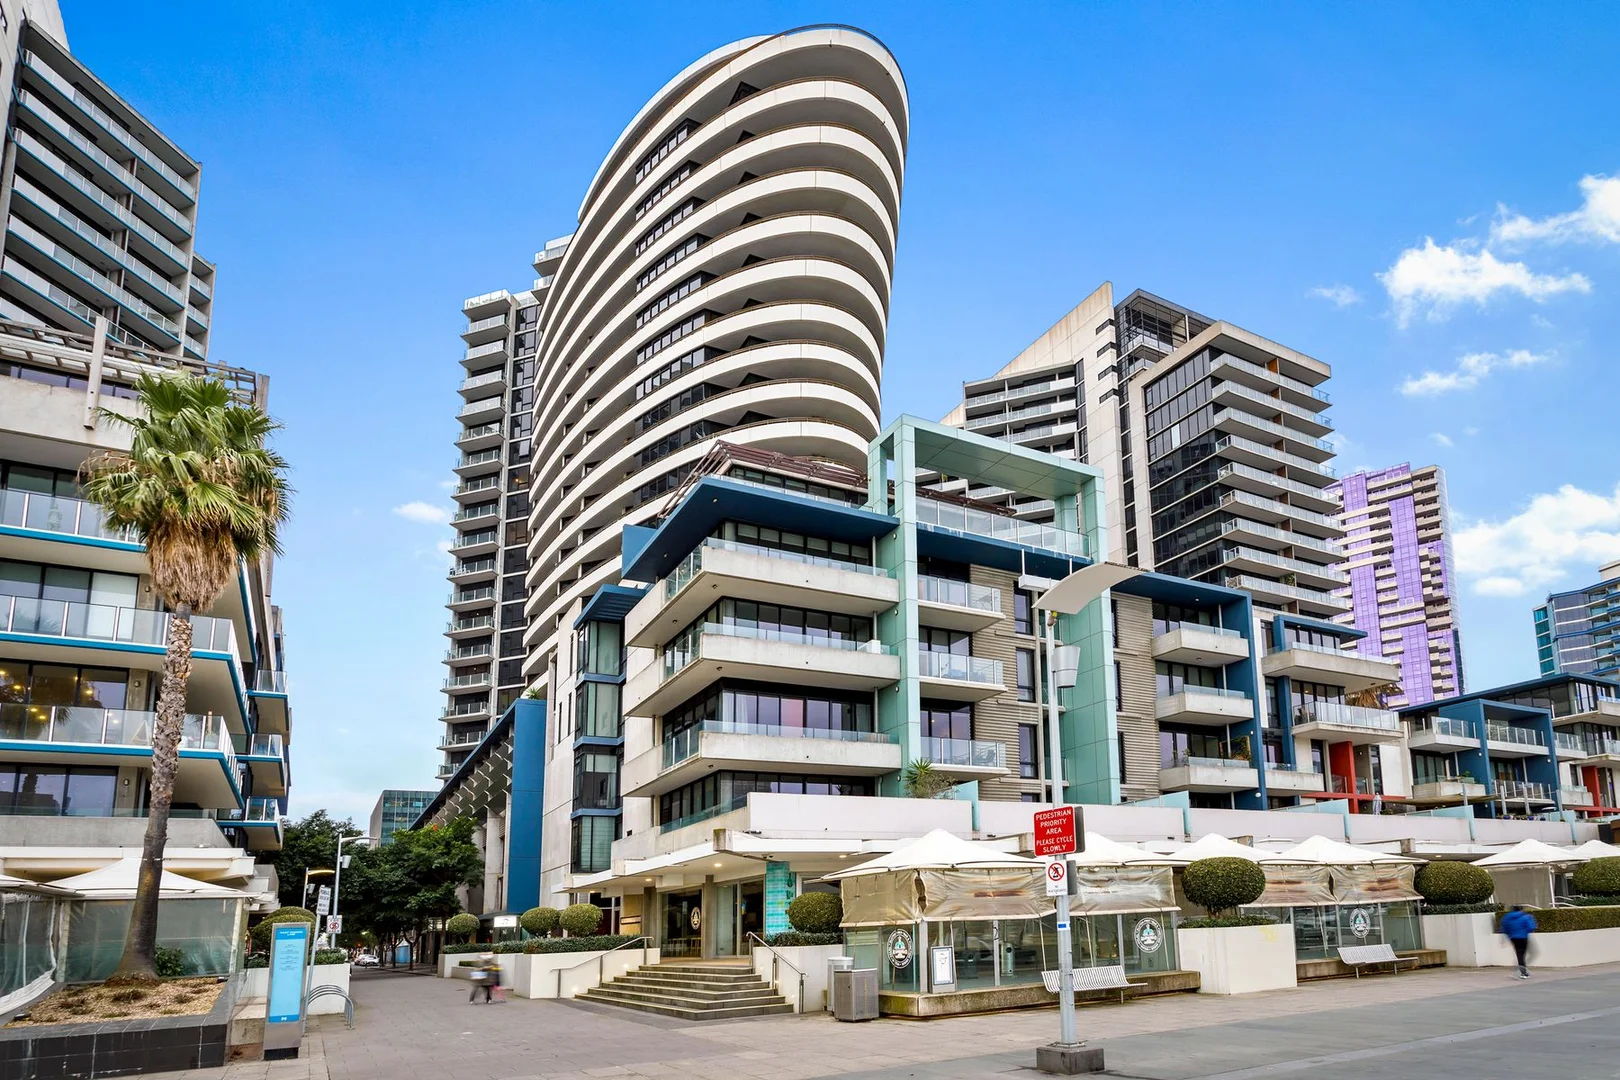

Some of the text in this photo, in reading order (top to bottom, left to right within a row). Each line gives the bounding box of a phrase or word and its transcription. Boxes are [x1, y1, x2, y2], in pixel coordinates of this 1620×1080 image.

[1036, 809, 1072, 820] PEDESTRIAN
[1040, 818, 1066, 828] PRIORITY
[1036, 835, 1073, 846] PLEASE CYCLE
[1042, 844, 1066, 852] SLOWLY
